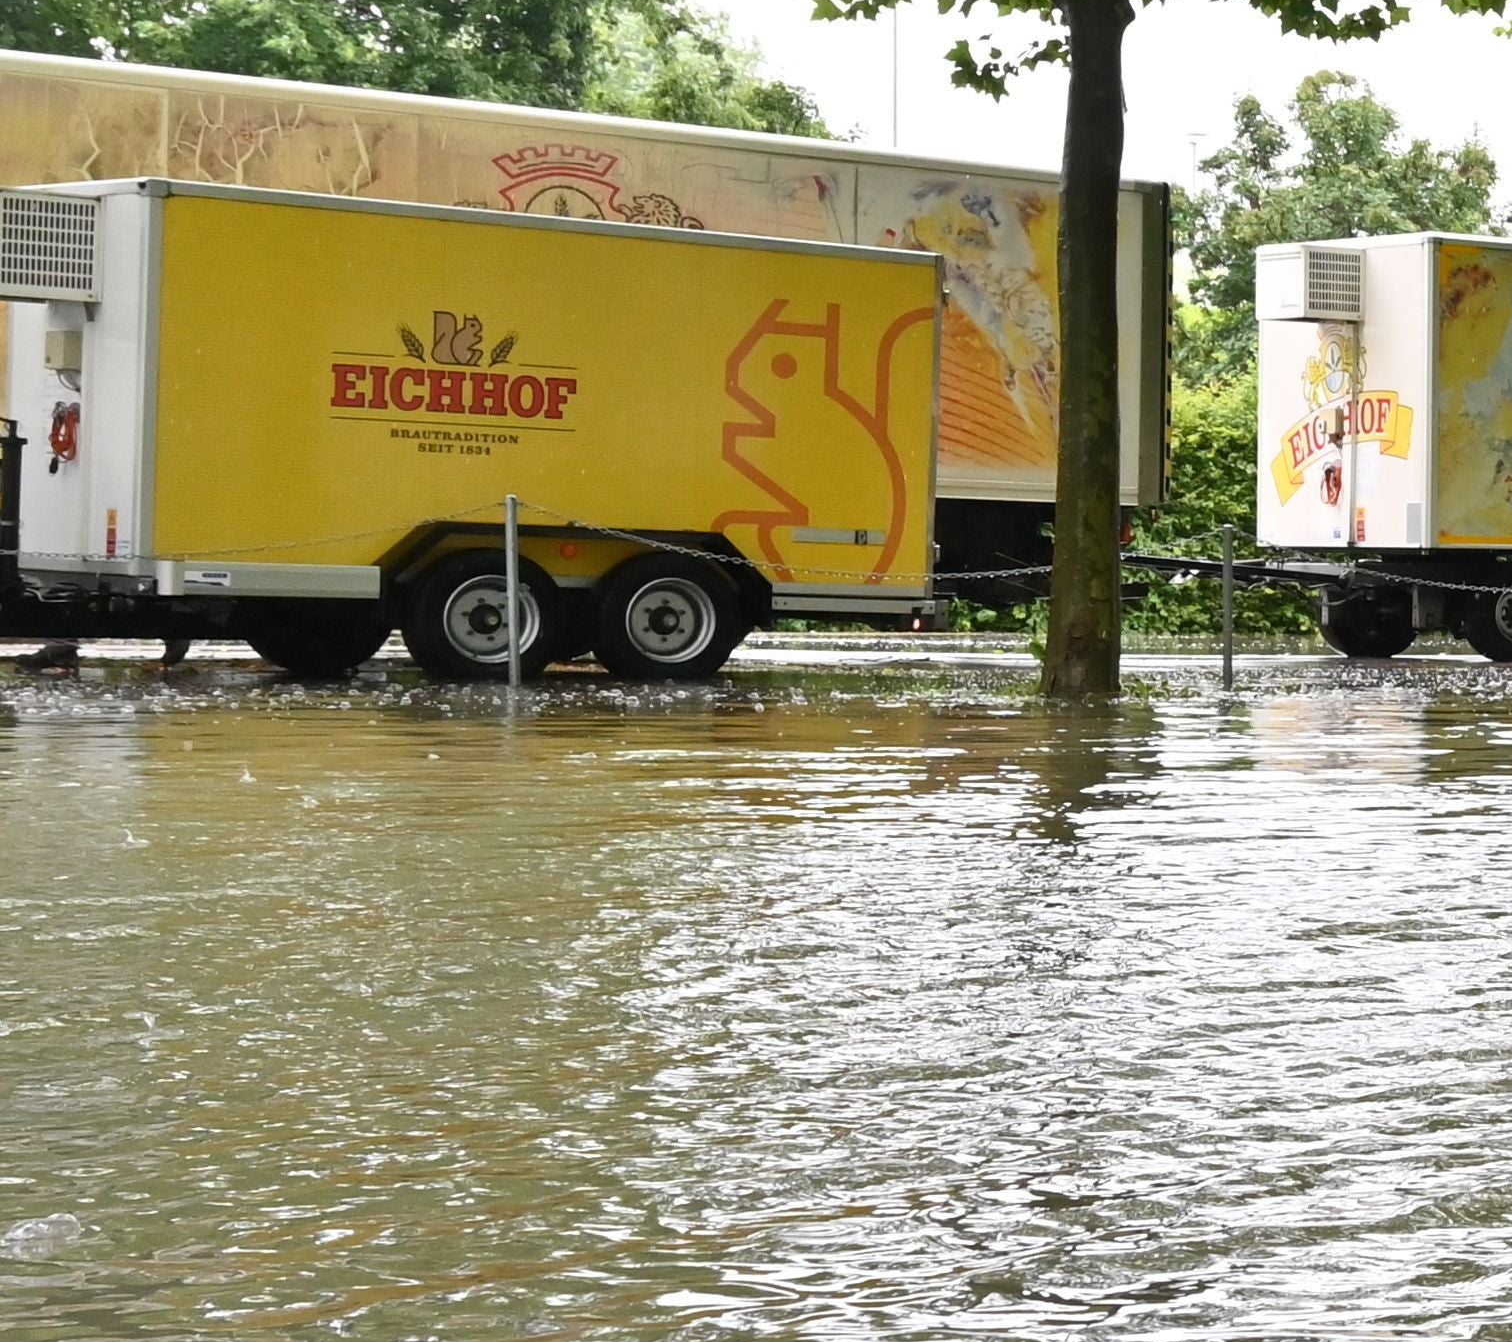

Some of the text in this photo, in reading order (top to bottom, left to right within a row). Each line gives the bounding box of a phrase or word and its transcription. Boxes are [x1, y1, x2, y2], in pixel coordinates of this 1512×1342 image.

[330, 363, 577, 419] EICHHOF
[390, 428, 519, 444] BRAUTRADITION
[417, 442, 491, 456] SEIT 1834
[1288, 398, 1391, 468] EICHOF
